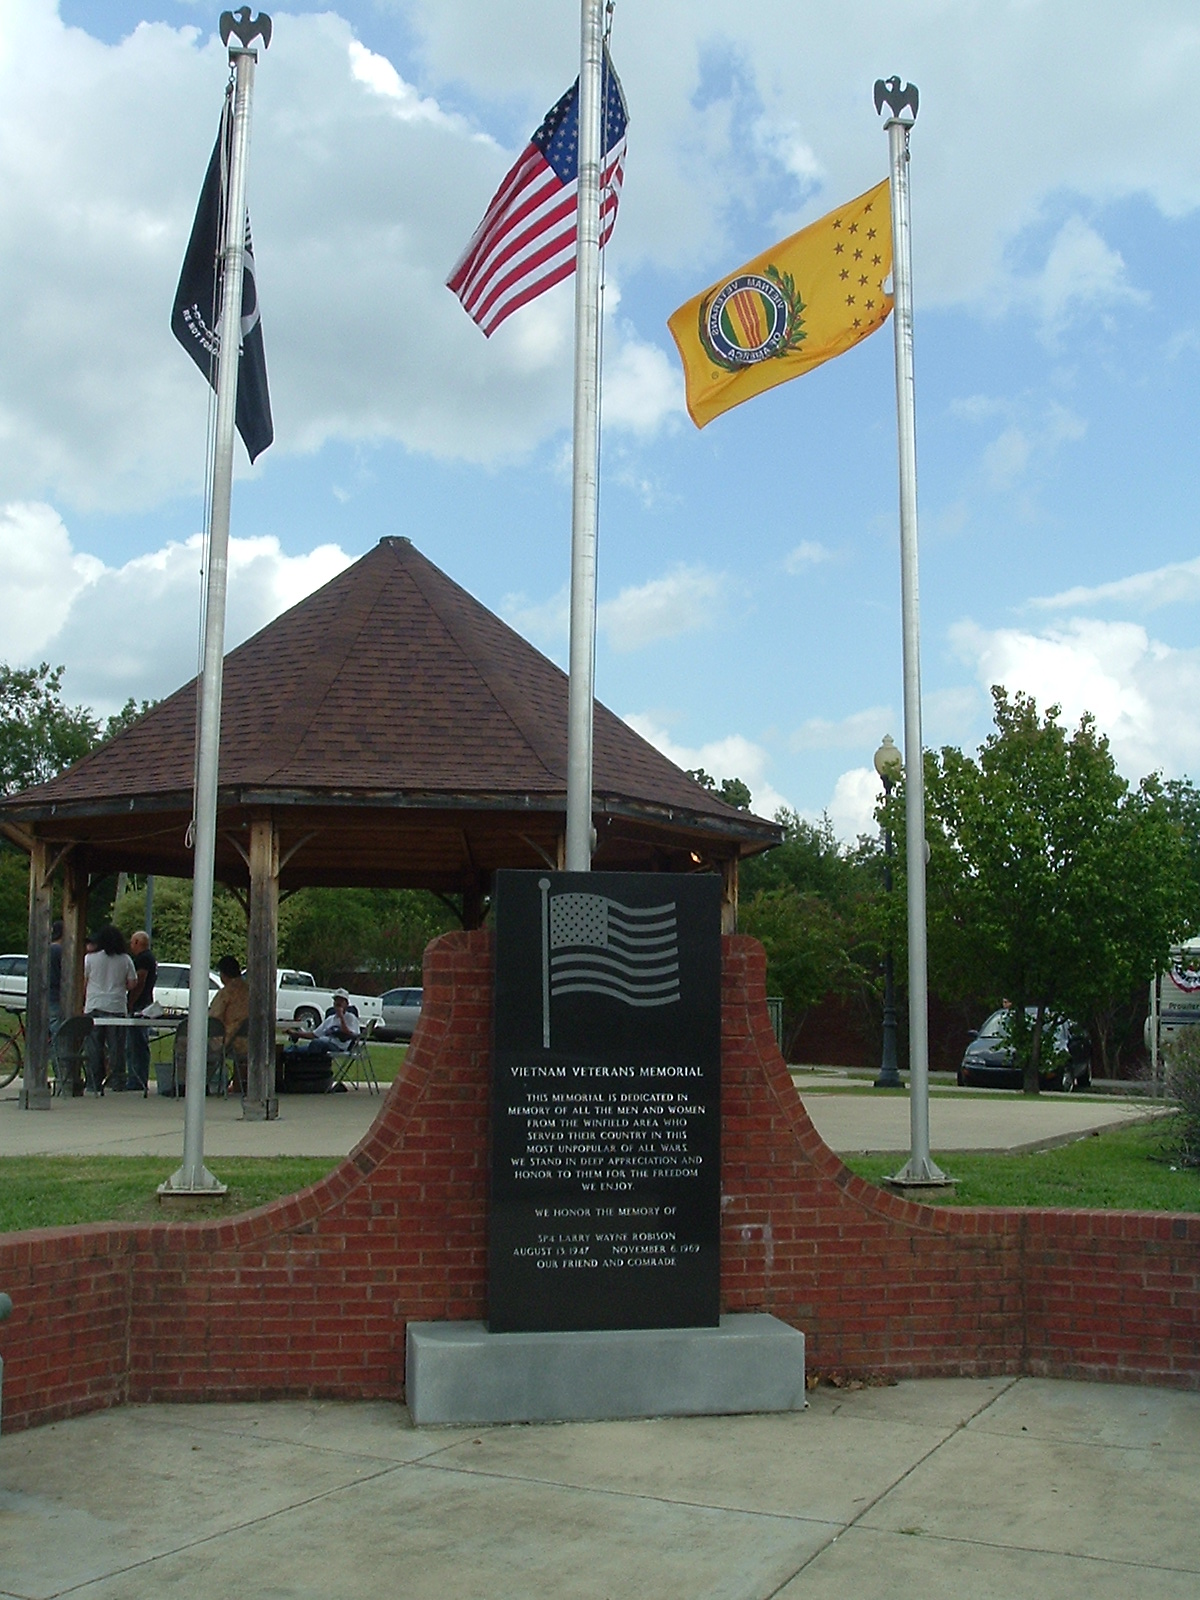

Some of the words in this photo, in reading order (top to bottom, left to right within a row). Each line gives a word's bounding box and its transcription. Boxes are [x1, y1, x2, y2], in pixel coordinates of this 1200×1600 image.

[510, 1067, 566, 1077] VIETNAM
[572, 1067, 635, 1077] VETERANS
[639, 1067, 704, 1077] MEMORIAL
[527, 1093, 548, 1102] THIS
[552, 1093, 604, 1102] MEMORIAL
[608, 1093, 617, 1103] IS
[620, 1093, 674, 1102] DEDICATED
[677, 1093, 688, 1102] IN
[507, 1106, 550, 1115] MEMORY
[554, 1106, 567, 1115] OF
[572, 1105, 591, 1115] ALL
[594, 1106, 613, 1115] THE
[617, 1106, 639, 1115] MEN
[642, 1106, 664, 1115] AND
[668, 1105, 706, 1114] WOMEN
[527, 1119, 556, 1128] FROM
[560, 1119, 578, 1128] THE
[583, 1118, 629, 1127] WINFIELD
[633, 1119, 659, 1127] AREA
[663, 1118, 688, 1127] WHO
[527, 1131, 564, 1141] SERVED
[567, 1131, 596, 1140] THEIR
[600, 1131, 647, 1140] COUNTRY
[651, 1131, 662, 1140] IN
[666, 1130, 687, 1140] THIS
[526, 1144, 554, 1154] MOST
[558, 1144, 616, 1153] UNPOPULAR
[620, 1143, 633, 1153] OF
[638, 1143, 655, 1152] ALL
[510, 1157, 525, 1166] WE
[529, 1157, 562, 1166] STAND
[565, 1157, 577, 1166] IN
[580, 1157, 604, 1165] DEEP
[608, 1156, 678, 1165] APPRECIATION
[681, 1155, 703, 1164] AND
[514, 1170, 552, 1179] HONOR
[557, 1170, 572, 1179] TO
[576, 1170, 602, 1179] THEM
[606, 1169, 626, 1178] FOR
[630, 1169, 649, 1178] THE
[581, 1182, 596, 1191] WE
[535, 1208, 550, 1217] WE
[553, 1208, 591, 1217] HONOR
[595, 1208, 614, 1217] THE
[618, 1207, 659, 1216] MEMORY
[663, 1206, 677, 1215] OF
[559, 1234, 590, 1242] LARRY
[595, 1233, 628, 1242] WAYNE
[513, 1247, 553, 1256] AUGUST
[612, 1245, 666, 1254] NOVEMBER
[536, 1259, 559, 1269] OUR
[562, 1259, 598, 1268] FRIEND
[602, 1258, 624, 1267] AND
[627, 1257, 677, 1267] COMRADE
